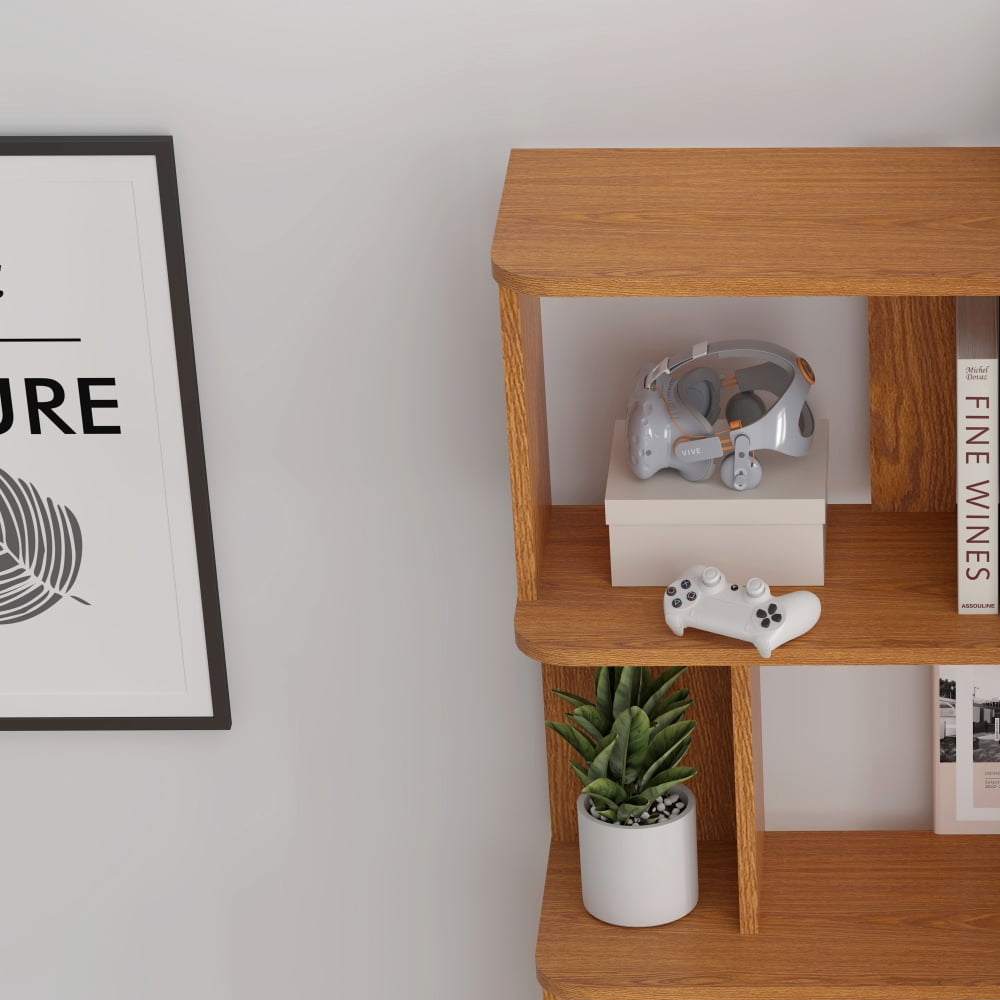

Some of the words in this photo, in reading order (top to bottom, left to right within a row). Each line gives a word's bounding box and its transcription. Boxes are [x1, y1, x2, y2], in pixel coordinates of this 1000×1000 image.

[681, 447, 702, 456] VIVE
[965, 396, 990, 464] FINE
[965, 480, 990, 581] WINES
